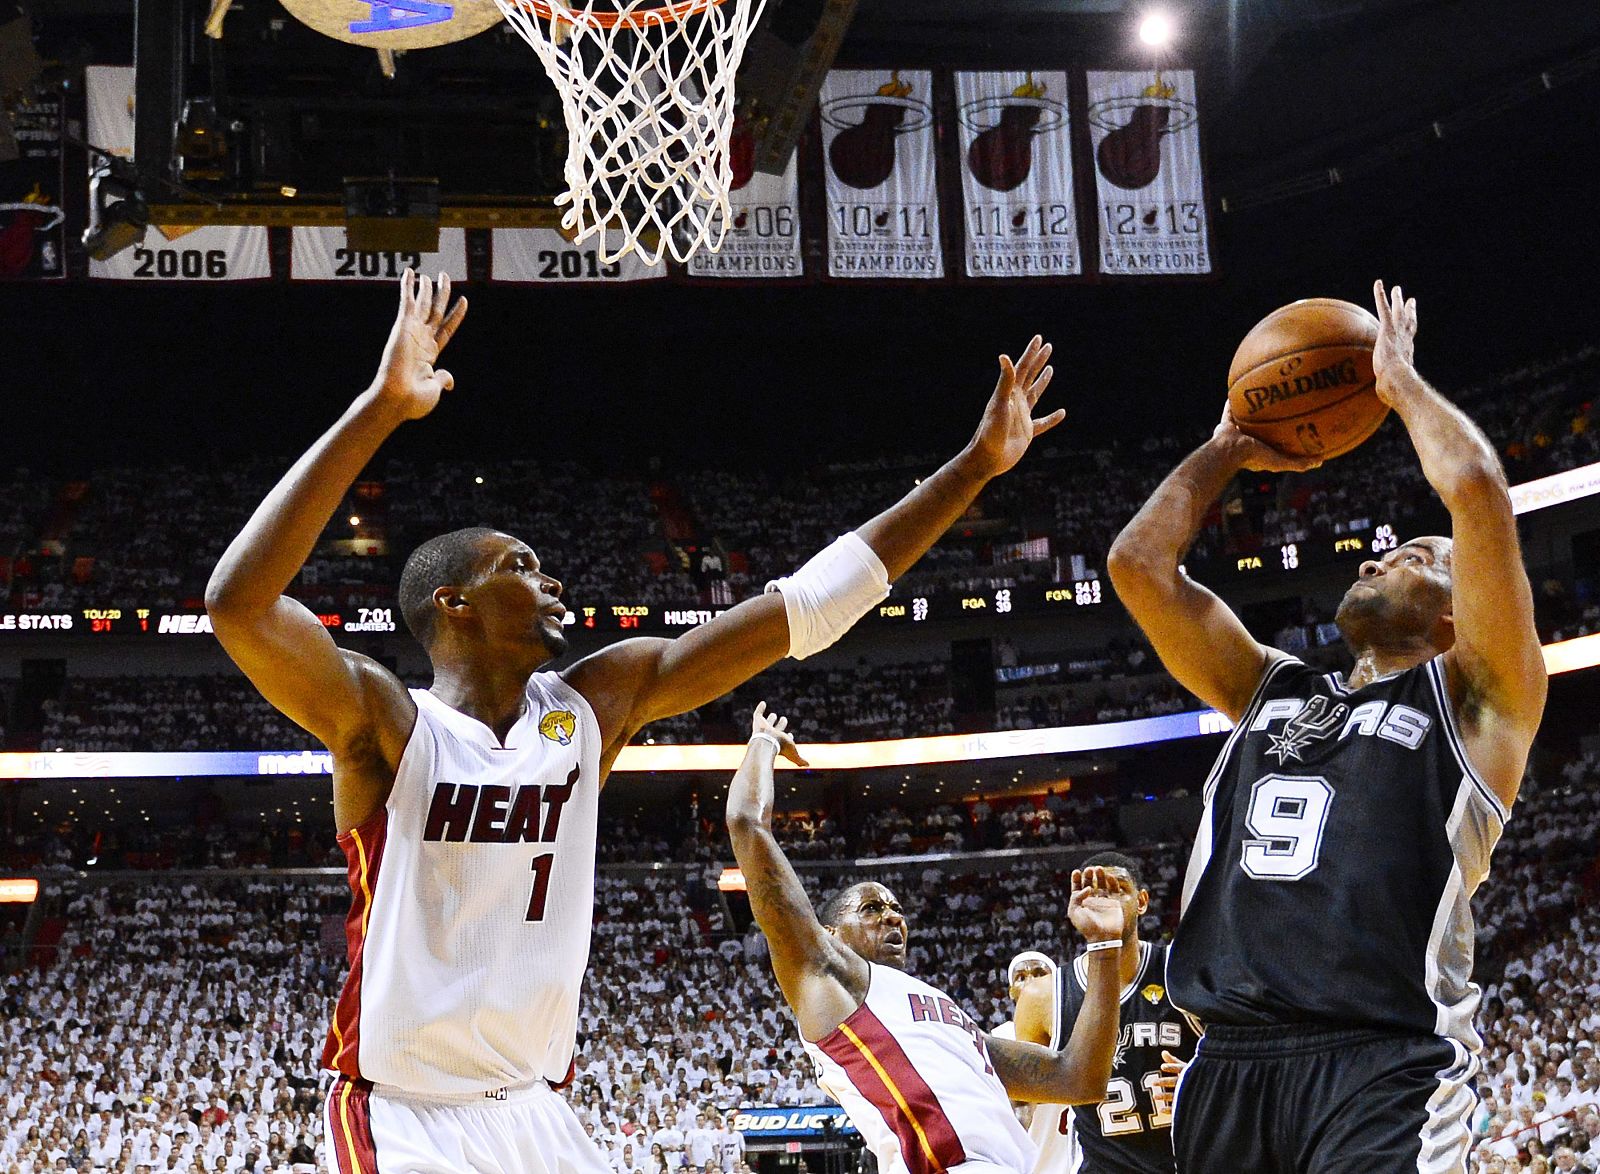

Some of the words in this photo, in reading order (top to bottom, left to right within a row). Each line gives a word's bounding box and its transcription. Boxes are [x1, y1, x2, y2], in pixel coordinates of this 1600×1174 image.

[755, 206, 793, 237] 06
[836, 206, 872, 236] 10
[900, 206, 931, 237] 11
[972, 206, 1003, 236] 11
[1035, 205, 1068, 235] 12
[1105, 205, 1137, 235] 12
[1165, 203, 1200, 234] 13
[133, 249, 227, 278] 2006
[335, 248, 421, 278] 2012
[693, 255, 796, 271] CHAMPIONS
[834, 255, 936, 271] CHAMPIONS
[972, 254, 1075, 271] CHAMPIONS
[1104, 252, 1205, 269] CHAMPIONS
[1243, 357, 1359, 414] SPALDING
[1335, 538, 1363, 552] FT%
[1237, 556, 1262, 571] FTA
[995, 590, 1011, 601] 42
[1045, 590, 1073, 601] FG%
[583, 607, 597, 617] TF
[880, 606, 905, 617] FGM
[912, 598, 928, 610] 23
[962, 598, 987, 610] FGA
[18, 614, 73, 630] STATS
[136, 609, 150, 619] TF
[357, 608, 392, 624] 7:01
[913, 609, 928, 621] 27
[91, 620, 112, 632] 3/1
[139, 620, 149, 632] 1
[158, 615, 214, 634] HEA
[344, 622, 389, 632] QUARTER
[389, 622, 396, 632] 3
[584, 616, 595, 629] 4
[619, 617, 639, 629] 3/1
[423, 762, 580, 843] HEAT
[1240, 773, 1335, 881] 9
[523, 853, 554, 923] 1
[908, 993, 985, 1055] HEA
[1096, 1070, 1174, 1136] 21
[733, 1113, 787, 1131] BUD
